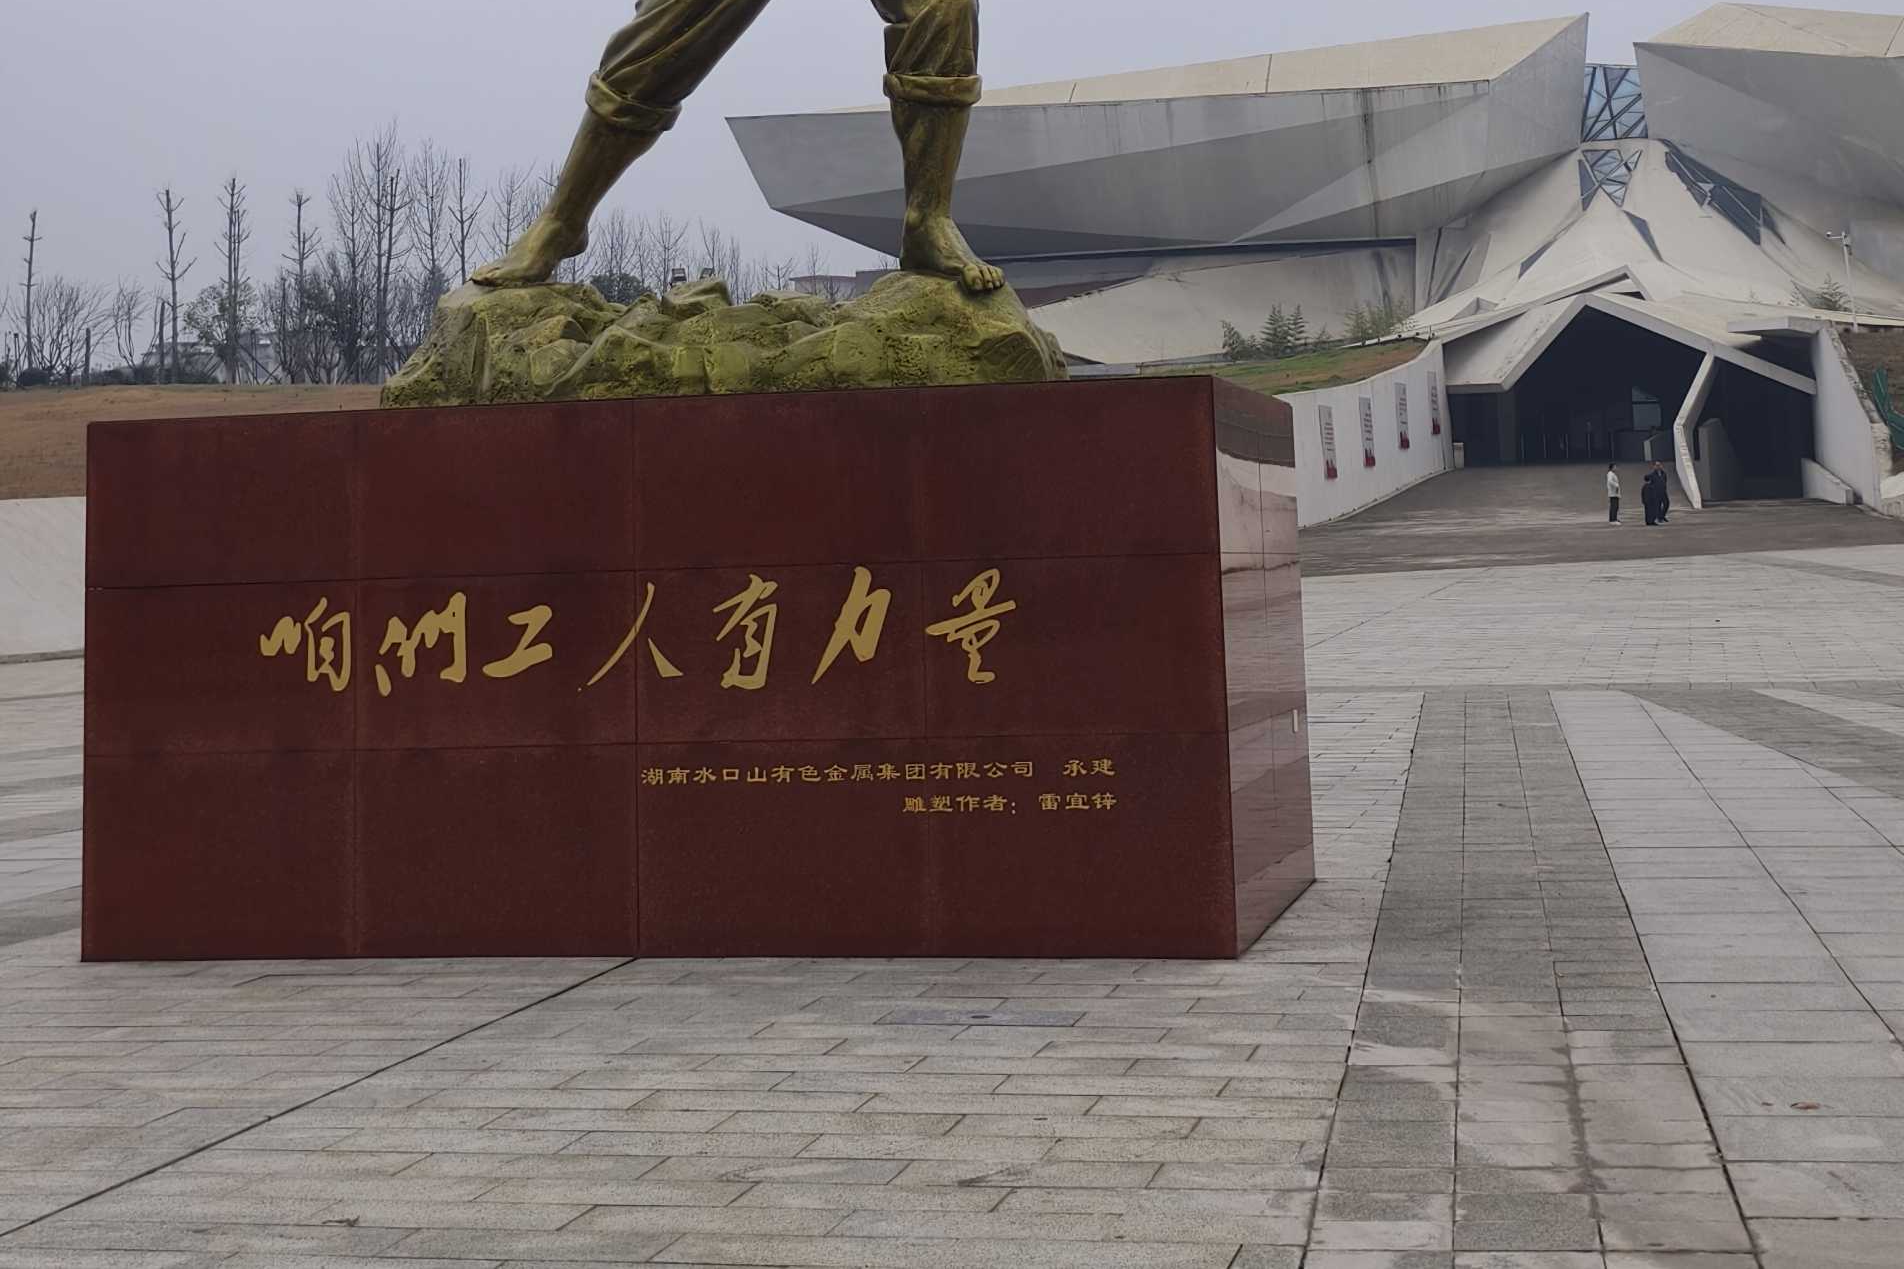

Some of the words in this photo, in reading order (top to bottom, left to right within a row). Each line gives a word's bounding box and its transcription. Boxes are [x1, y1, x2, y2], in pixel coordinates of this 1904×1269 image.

[640, 761, 1033, 786] 湖南水口山有色金属集团有限公司
[1062, 758, 1116, 777] 承建
